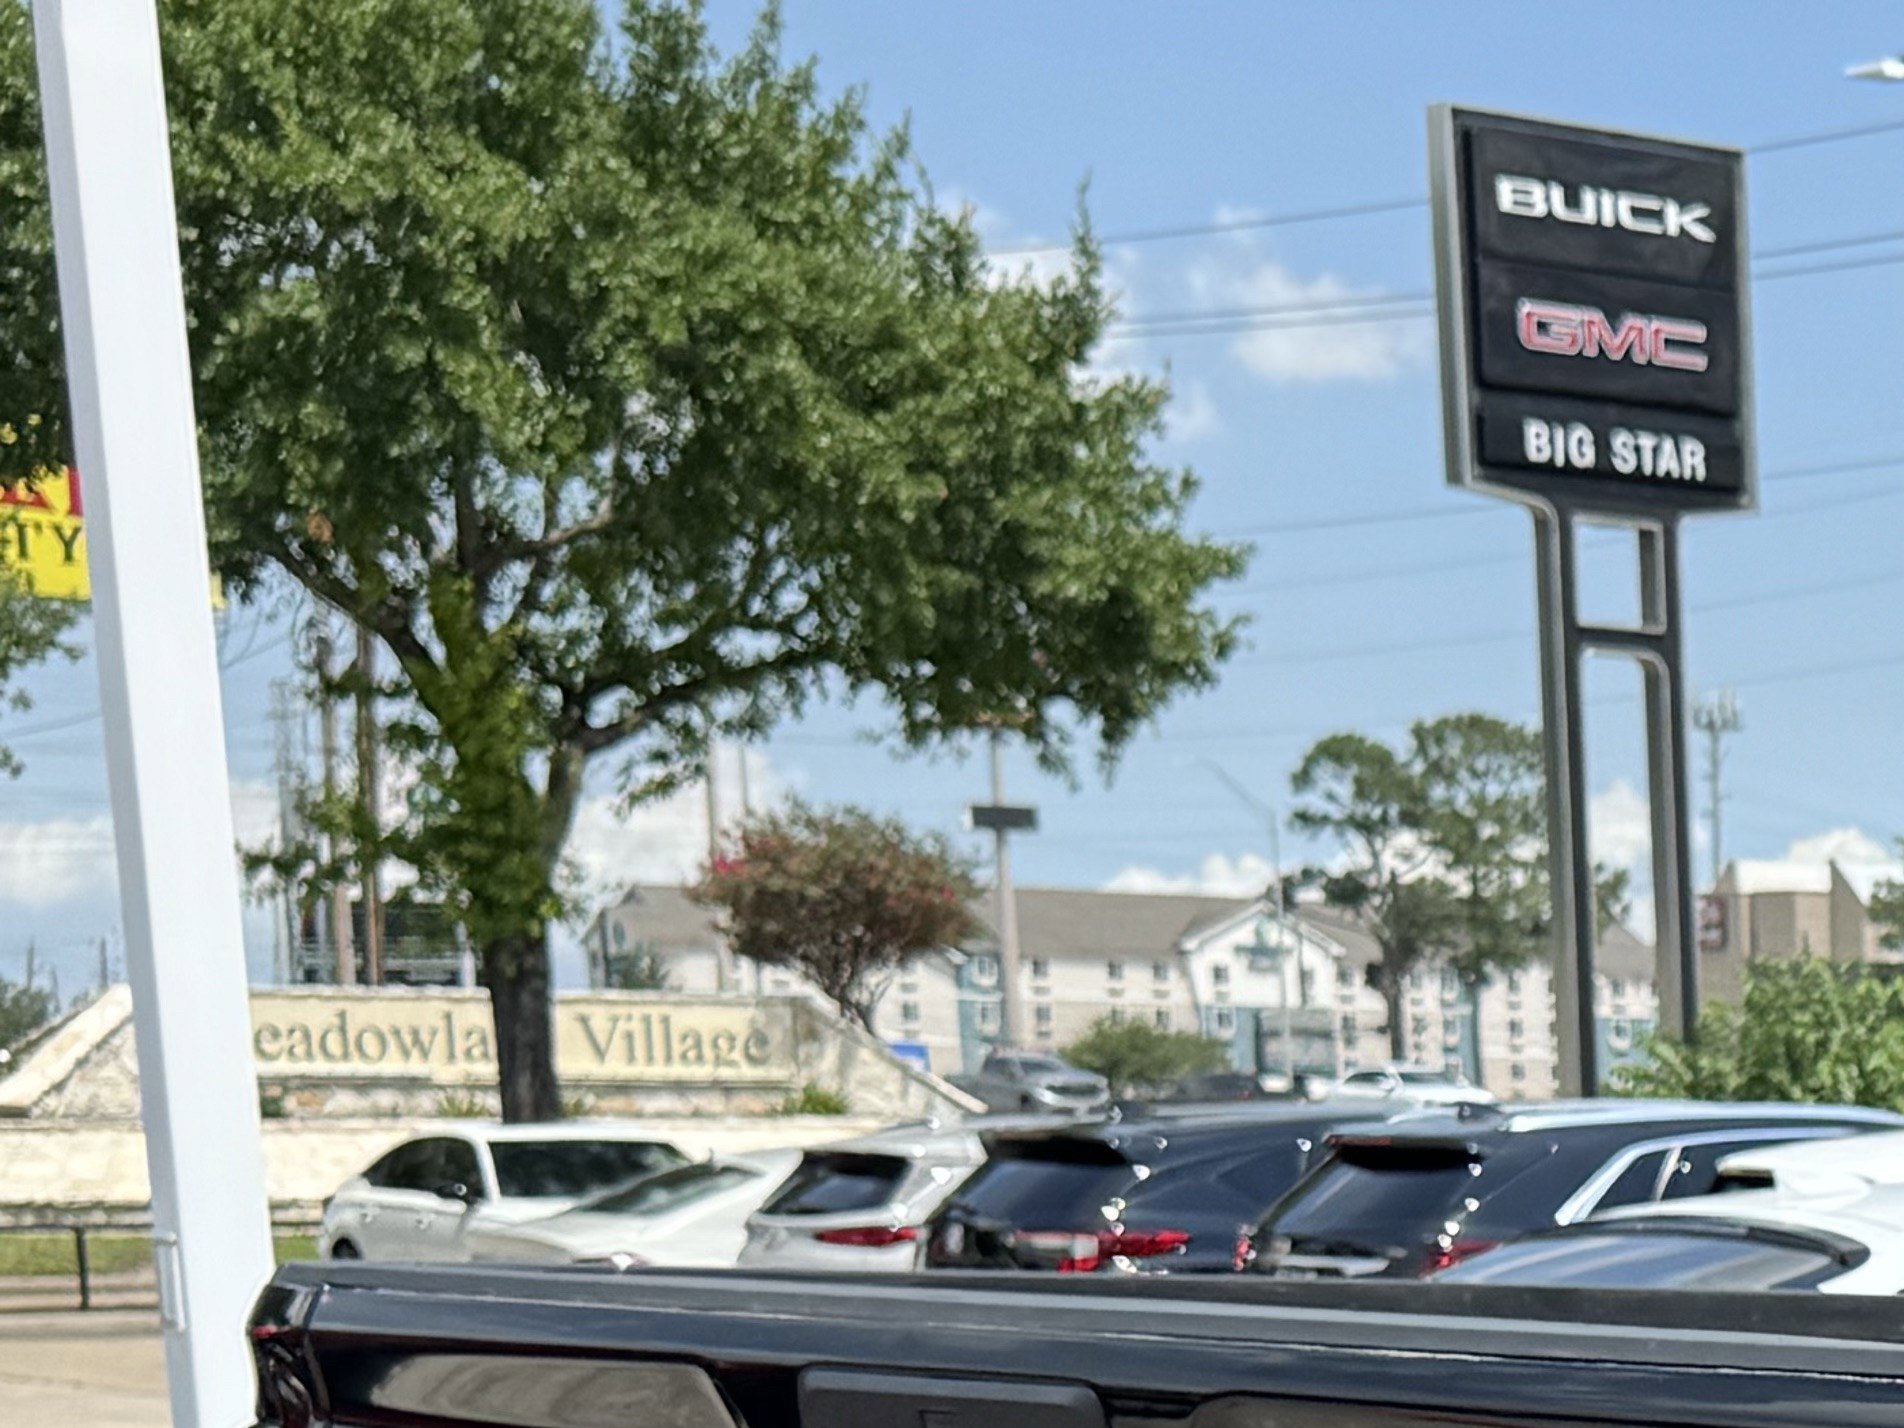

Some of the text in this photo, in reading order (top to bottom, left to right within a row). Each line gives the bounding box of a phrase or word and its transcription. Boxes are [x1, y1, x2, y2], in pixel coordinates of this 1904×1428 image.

[1495, 173, 1716, 243] BUICK
[1516, 297, 1709, 373] GMC
[1522, 417, 1707, 482] BIG STAR
[253, 1009, 770, 1068] eadowla Village
